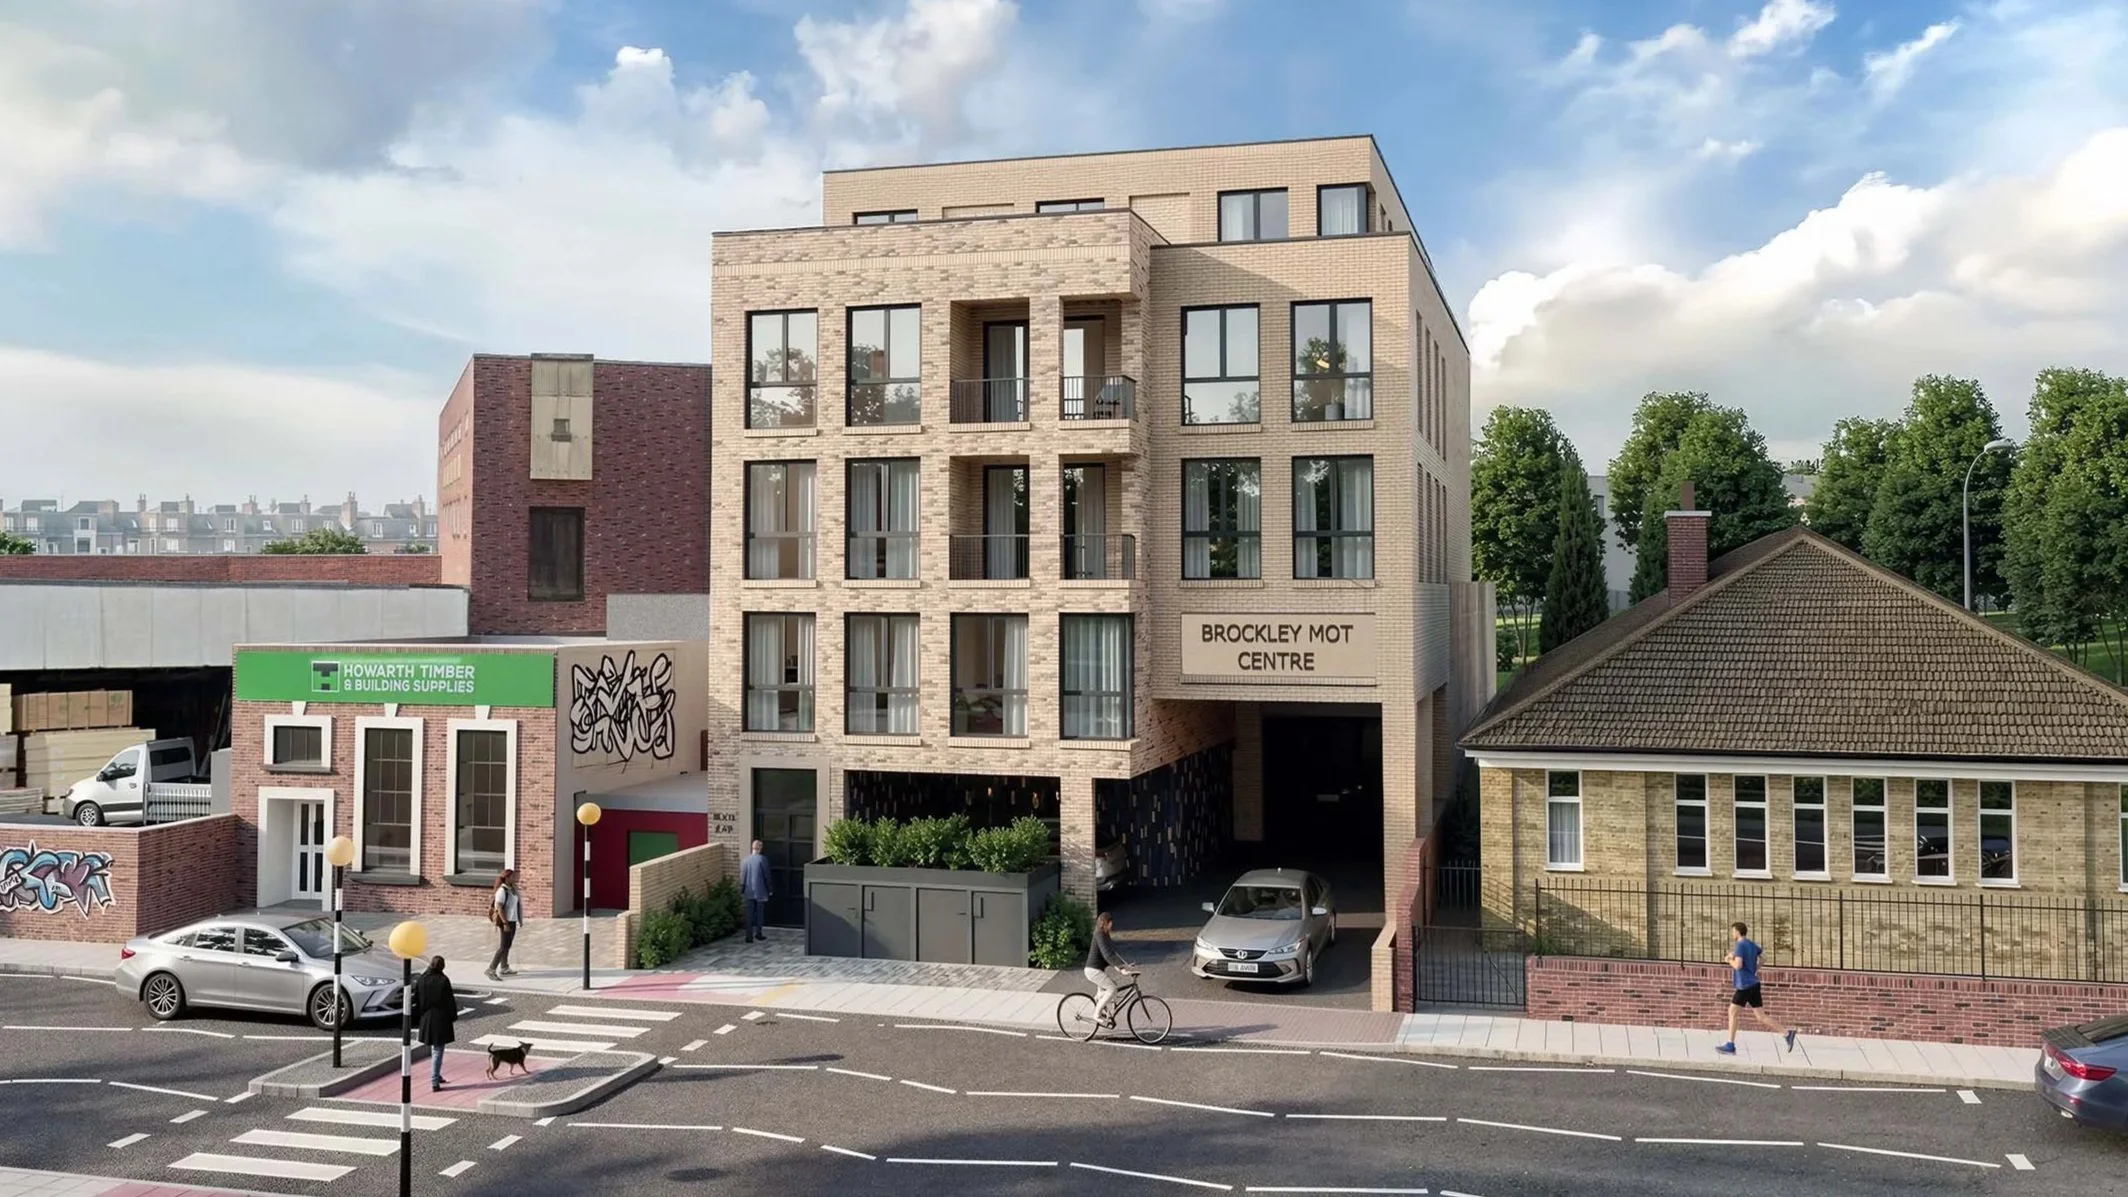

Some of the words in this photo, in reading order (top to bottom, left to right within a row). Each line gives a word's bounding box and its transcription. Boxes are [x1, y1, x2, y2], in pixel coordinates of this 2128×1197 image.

[1202, 624, 1302, 643] BROCKLEY
[1309, 624, 1353, 643] MOT
[1238, 651, 1315, 671] CENTRE
[344, 664, 414, 678] HOWARTH
[420, 665, 475, 679] TIMBER
[344, 679, 352, 691] &
[355, 679, 410, 692] BUILDING
[413, 680, 475, 693] SUPPLIES
